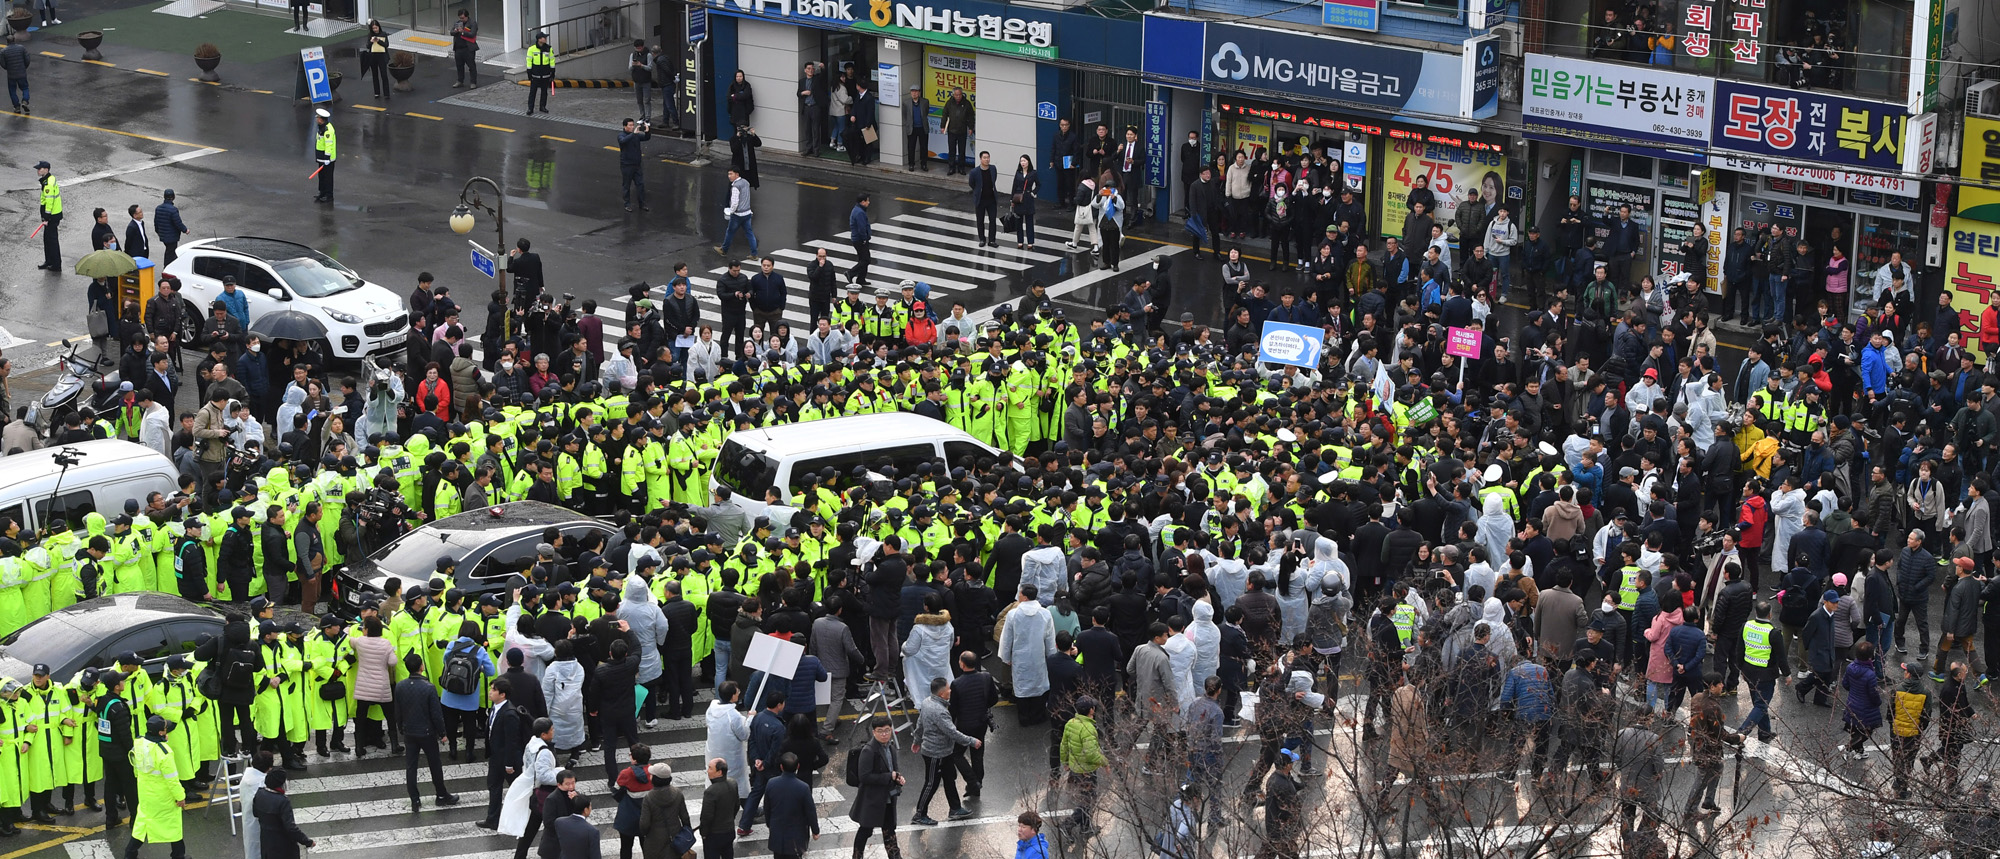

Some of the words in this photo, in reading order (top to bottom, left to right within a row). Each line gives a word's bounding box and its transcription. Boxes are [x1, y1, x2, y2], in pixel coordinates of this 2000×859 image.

[797, 0, 855, 21] Bank
[1330, 15, 1369, 26] 233-1100
[1682, 4, 1713, 57] 회생
[1730, 12, 1762, 64] 파산
[1928, 33, 1940, 86] 사무소
[1686, 88, 1706, 104] 중개
[1040, 109, 1055, 118] 73-1
[1529, 106, 1566, 118] 대표공인중개사
[1685, 104, 1705, 119] 경매
[1724, 92, 1802, 150] 도장
[1238, 124, 1251, 133] 2018
[1652, 123, 1703, 138] 062-430-3939
[1836, 107, 1907, 165] 복사
[1393, 139, 1424, 157] 2018
[1920, 120, 1934, 173] 도장
[1151, 157, 1161, 186] 사무소
[1844, 172, 1905, 192] F.226-4791
[1749, 201, 1795, 219] 우표
[1705, 214, 1723, 292] 부동산경매
